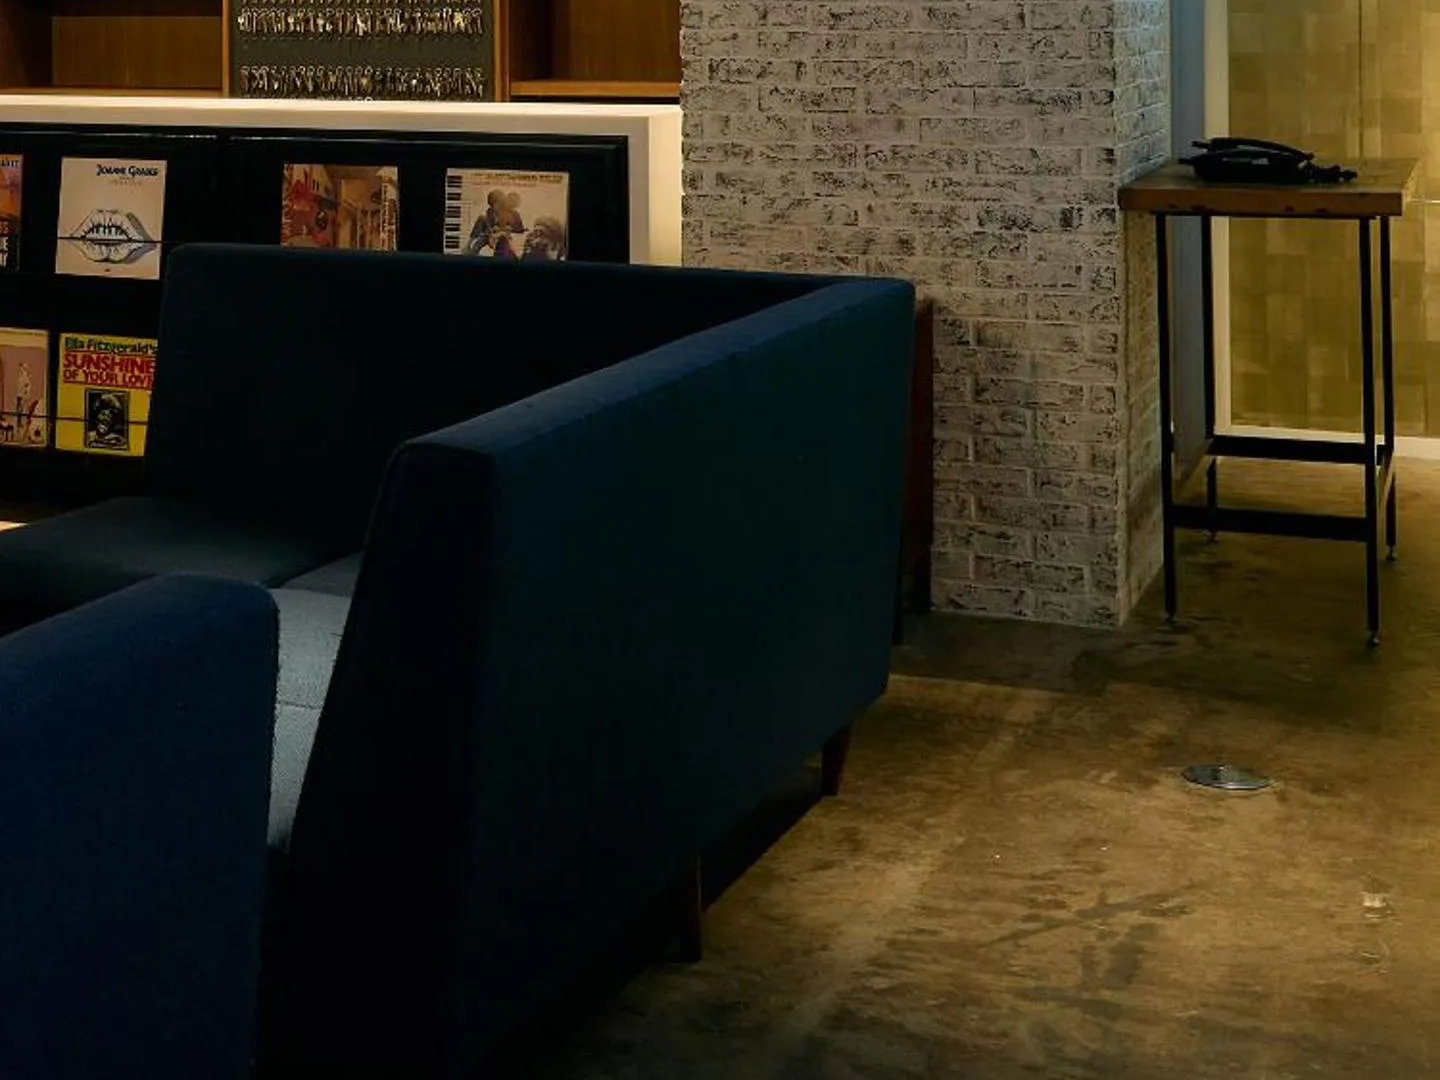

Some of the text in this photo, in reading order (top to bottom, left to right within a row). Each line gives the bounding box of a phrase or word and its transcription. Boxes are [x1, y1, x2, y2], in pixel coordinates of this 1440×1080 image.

[64, 352, 156, 375] SUNSHINE
[63, 369, 78, 380] OF
[83, 370, 118, 384] YOUR
